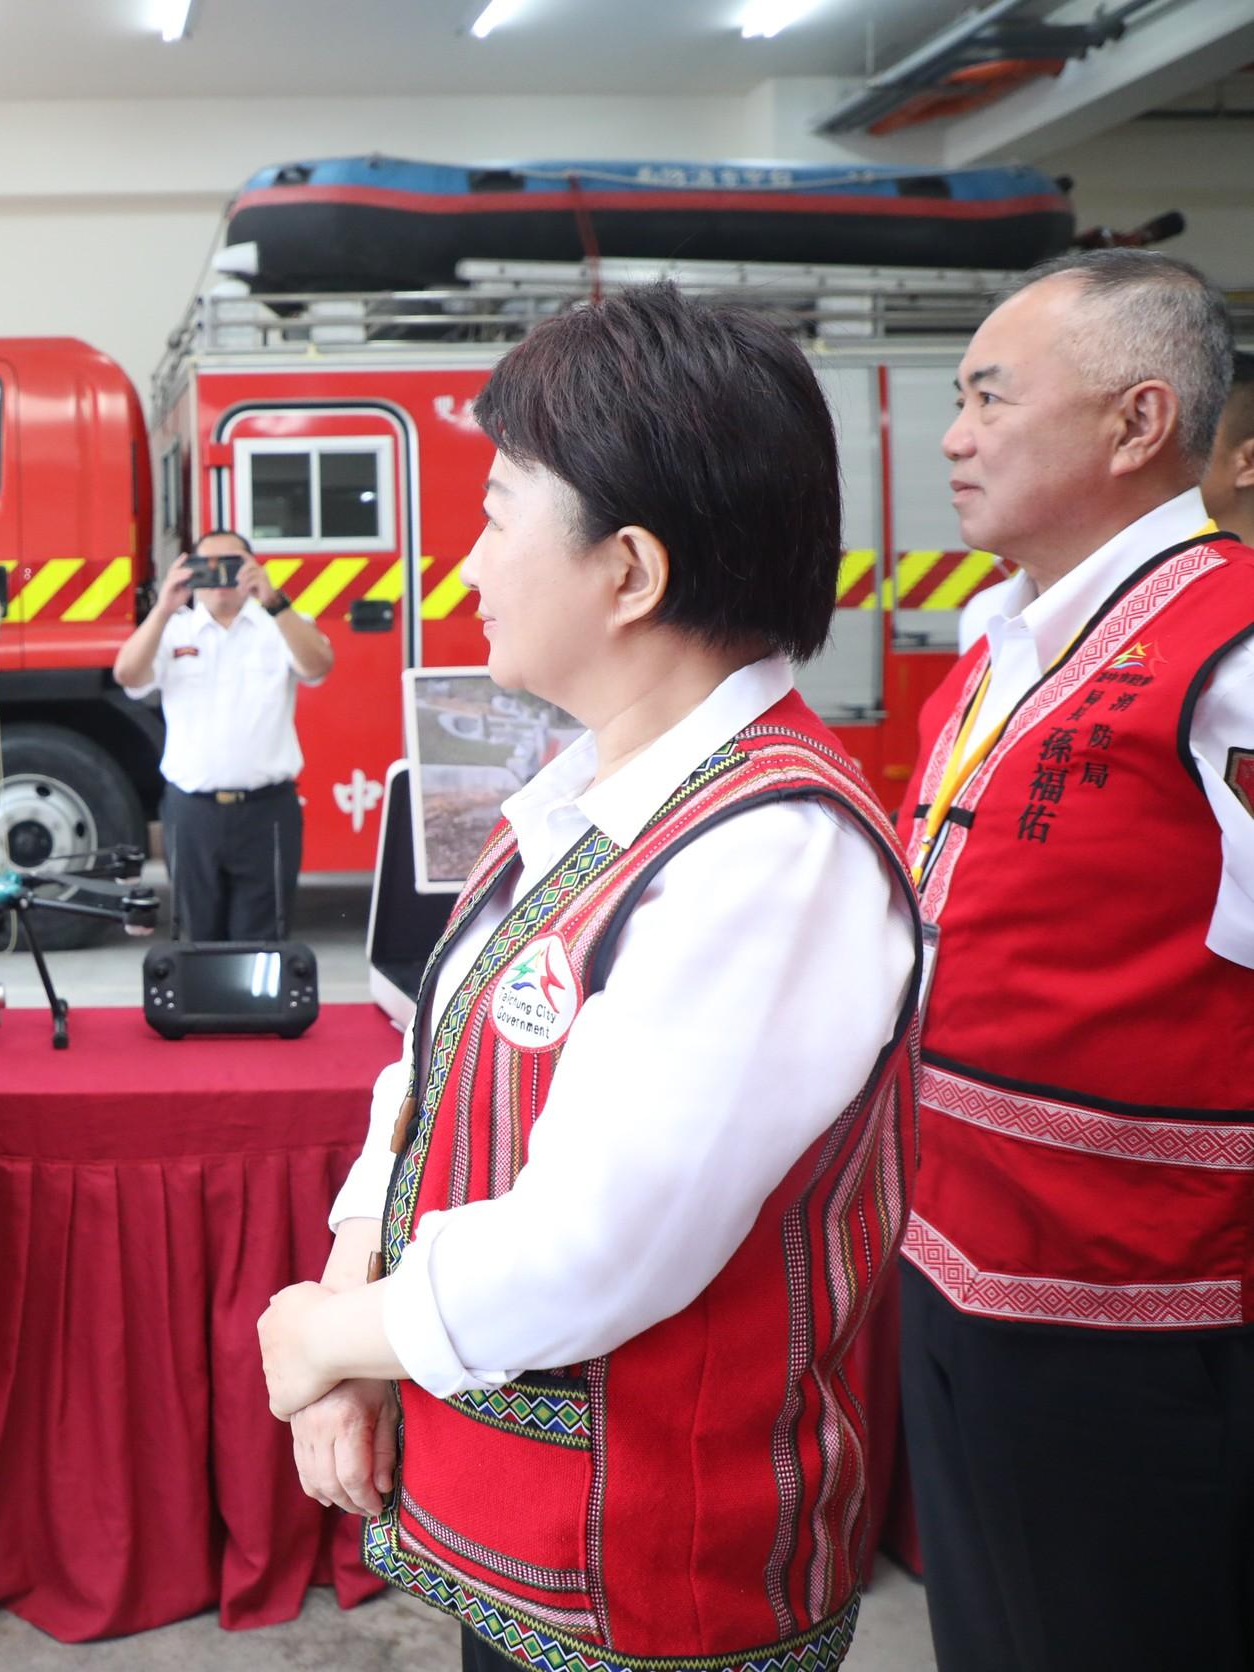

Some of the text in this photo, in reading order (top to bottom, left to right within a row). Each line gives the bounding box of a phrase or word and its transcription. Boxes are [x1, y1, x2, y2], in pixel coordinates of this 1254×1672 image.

[1016, 726, 1078, 844] 孫福佑
[496, 1006, 551, 1040] Government
[499, 986, 556, 1025] Taichung City
